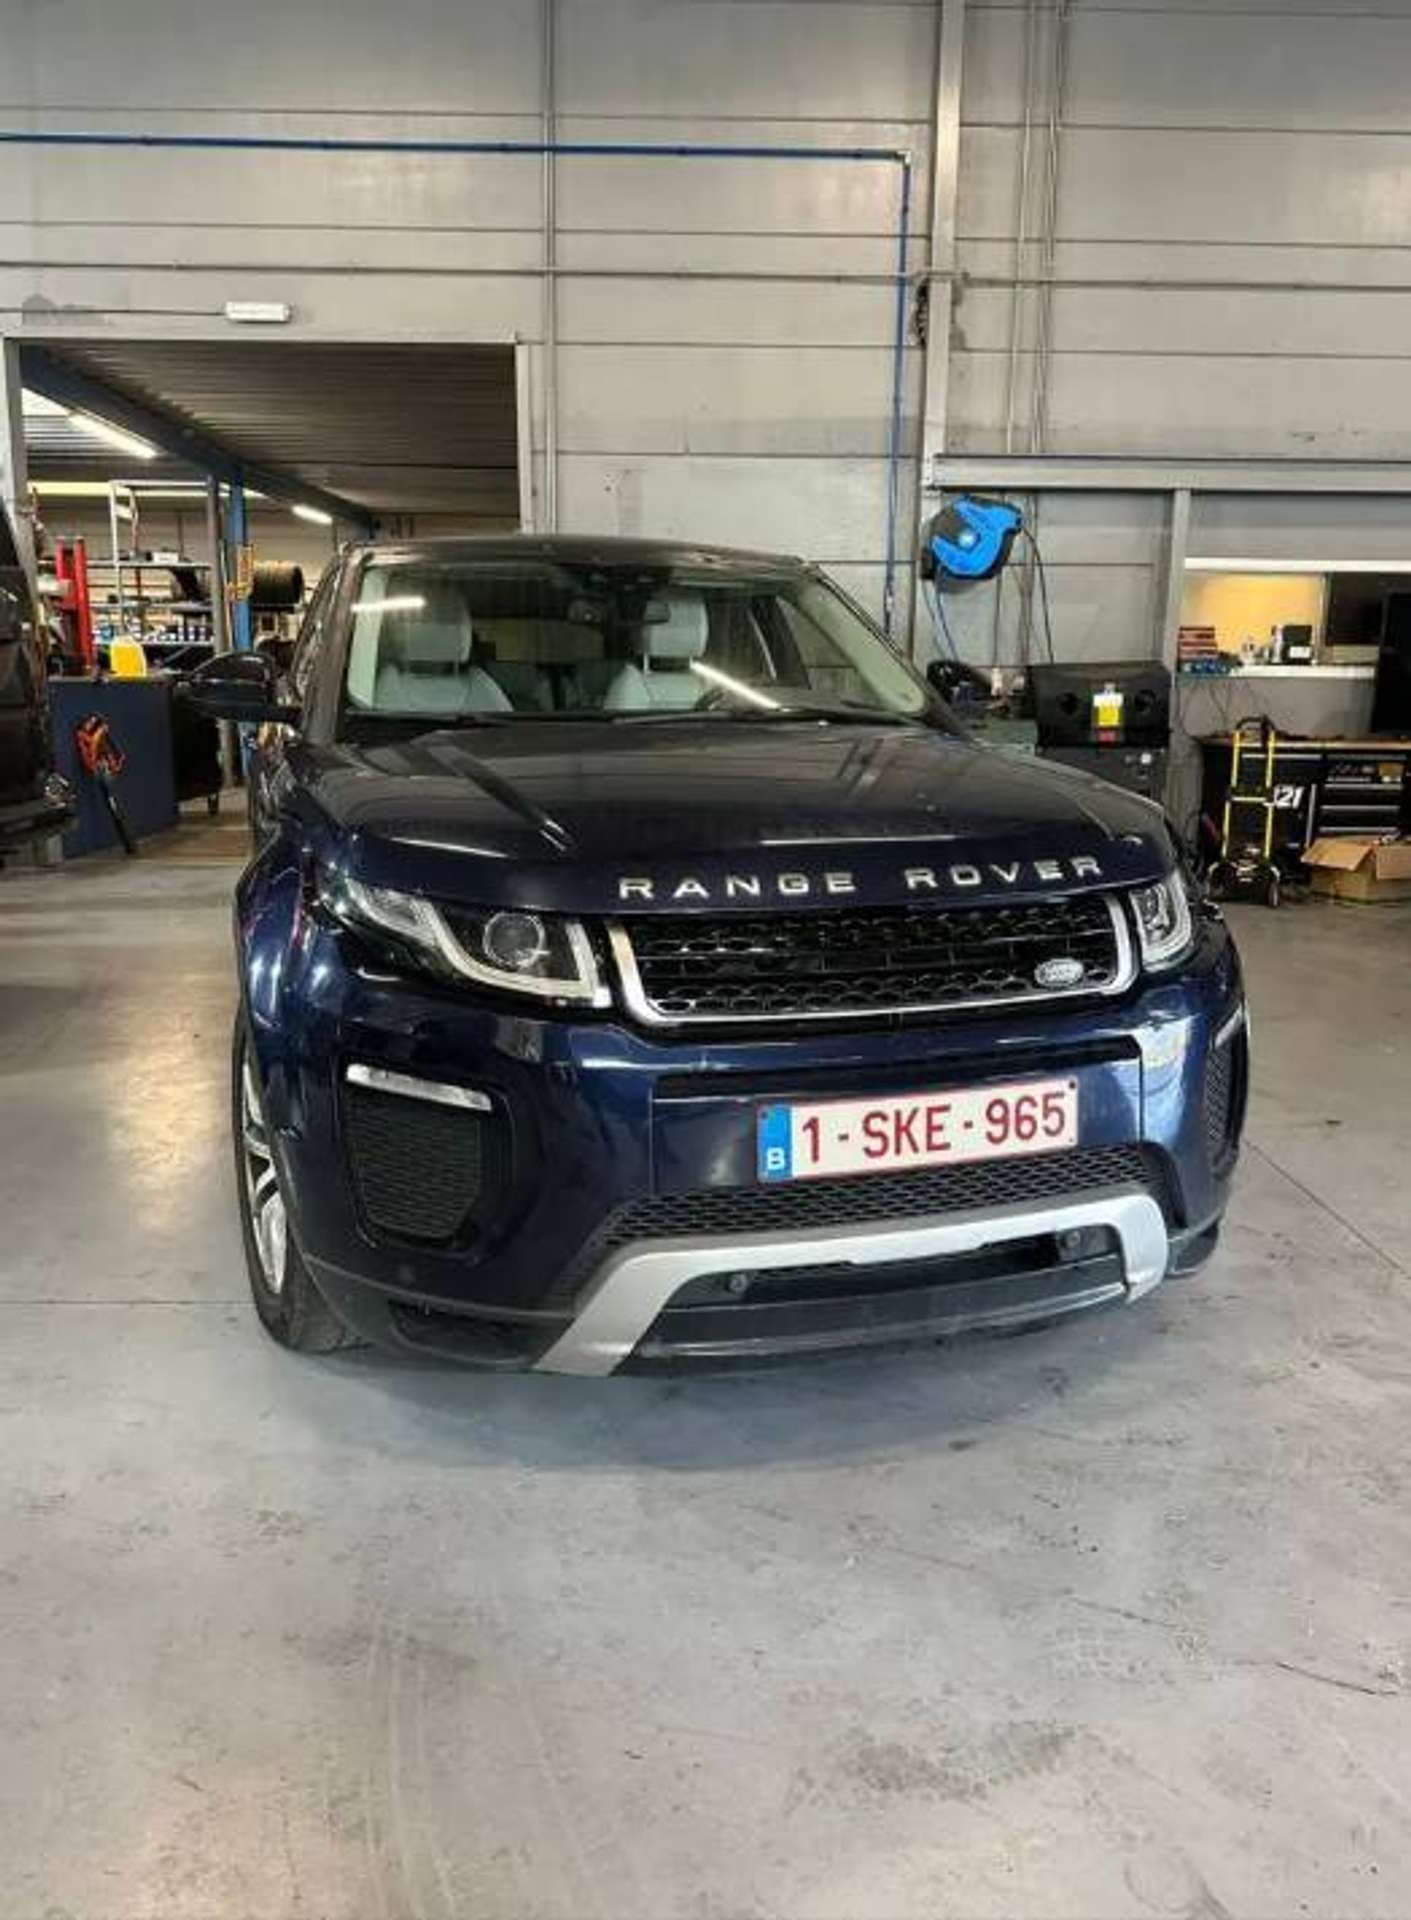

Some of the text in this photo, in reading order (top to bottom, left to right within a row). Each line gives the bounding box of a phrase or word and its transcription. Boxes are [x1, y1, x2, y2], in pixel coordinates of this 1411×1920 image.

[618, 856, 1102, 900] RANGE ROVER
[766, 1148, 785, 1170] B
